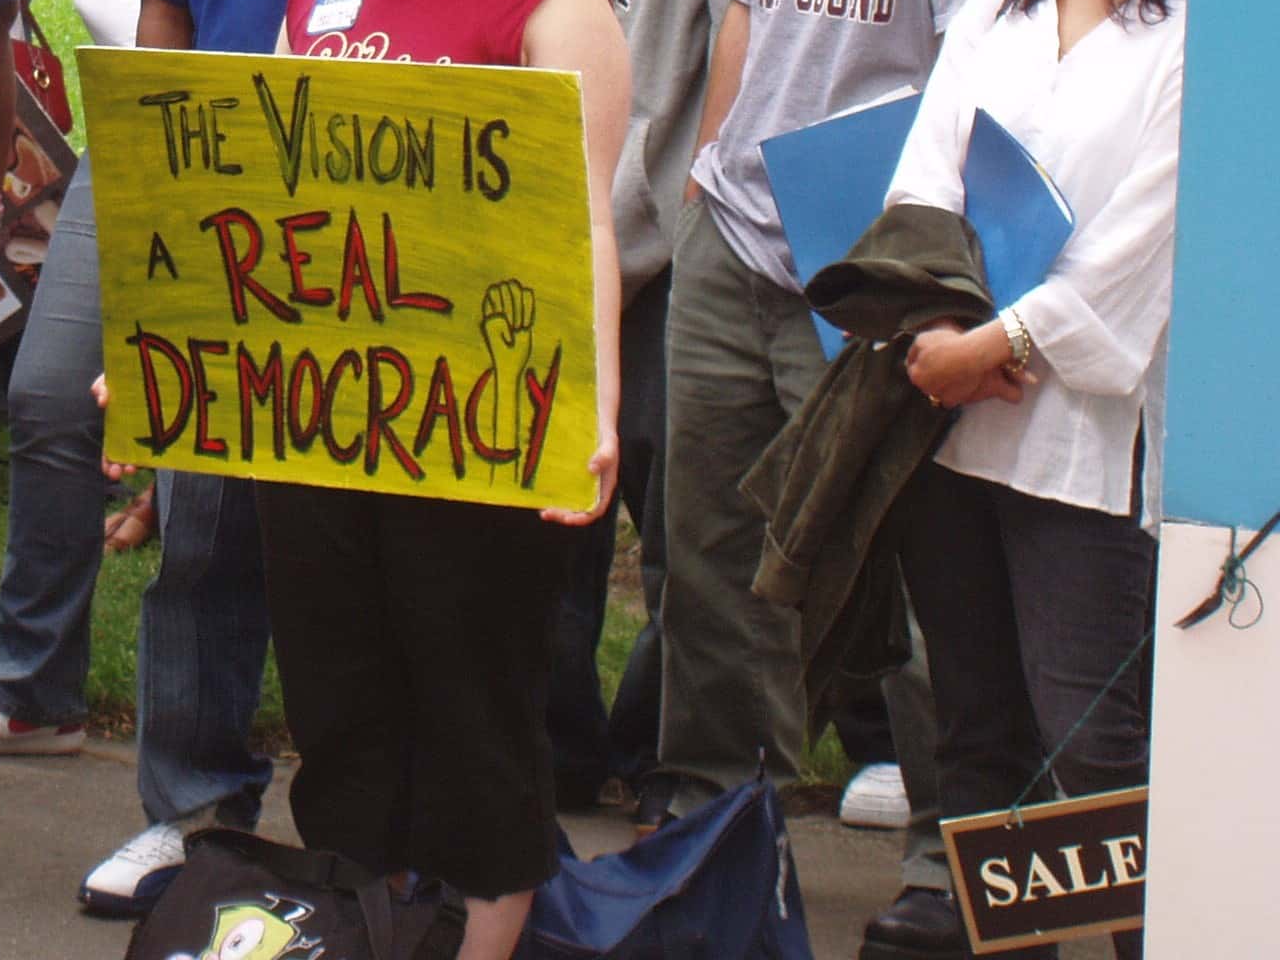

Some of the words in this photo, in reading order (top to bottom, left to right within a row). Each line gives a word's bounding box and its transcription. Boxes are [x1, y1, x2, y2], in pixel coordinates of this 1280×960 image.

[139, 91, 242, 179] THE
[463, 117, 510, 201] IS
[148, 232, 178, 280] A
[199, 207, 452, 324] REAL
[125, 321, 560, 490] DEMOCRACY
[979, 834, 1147, 908] SALE
